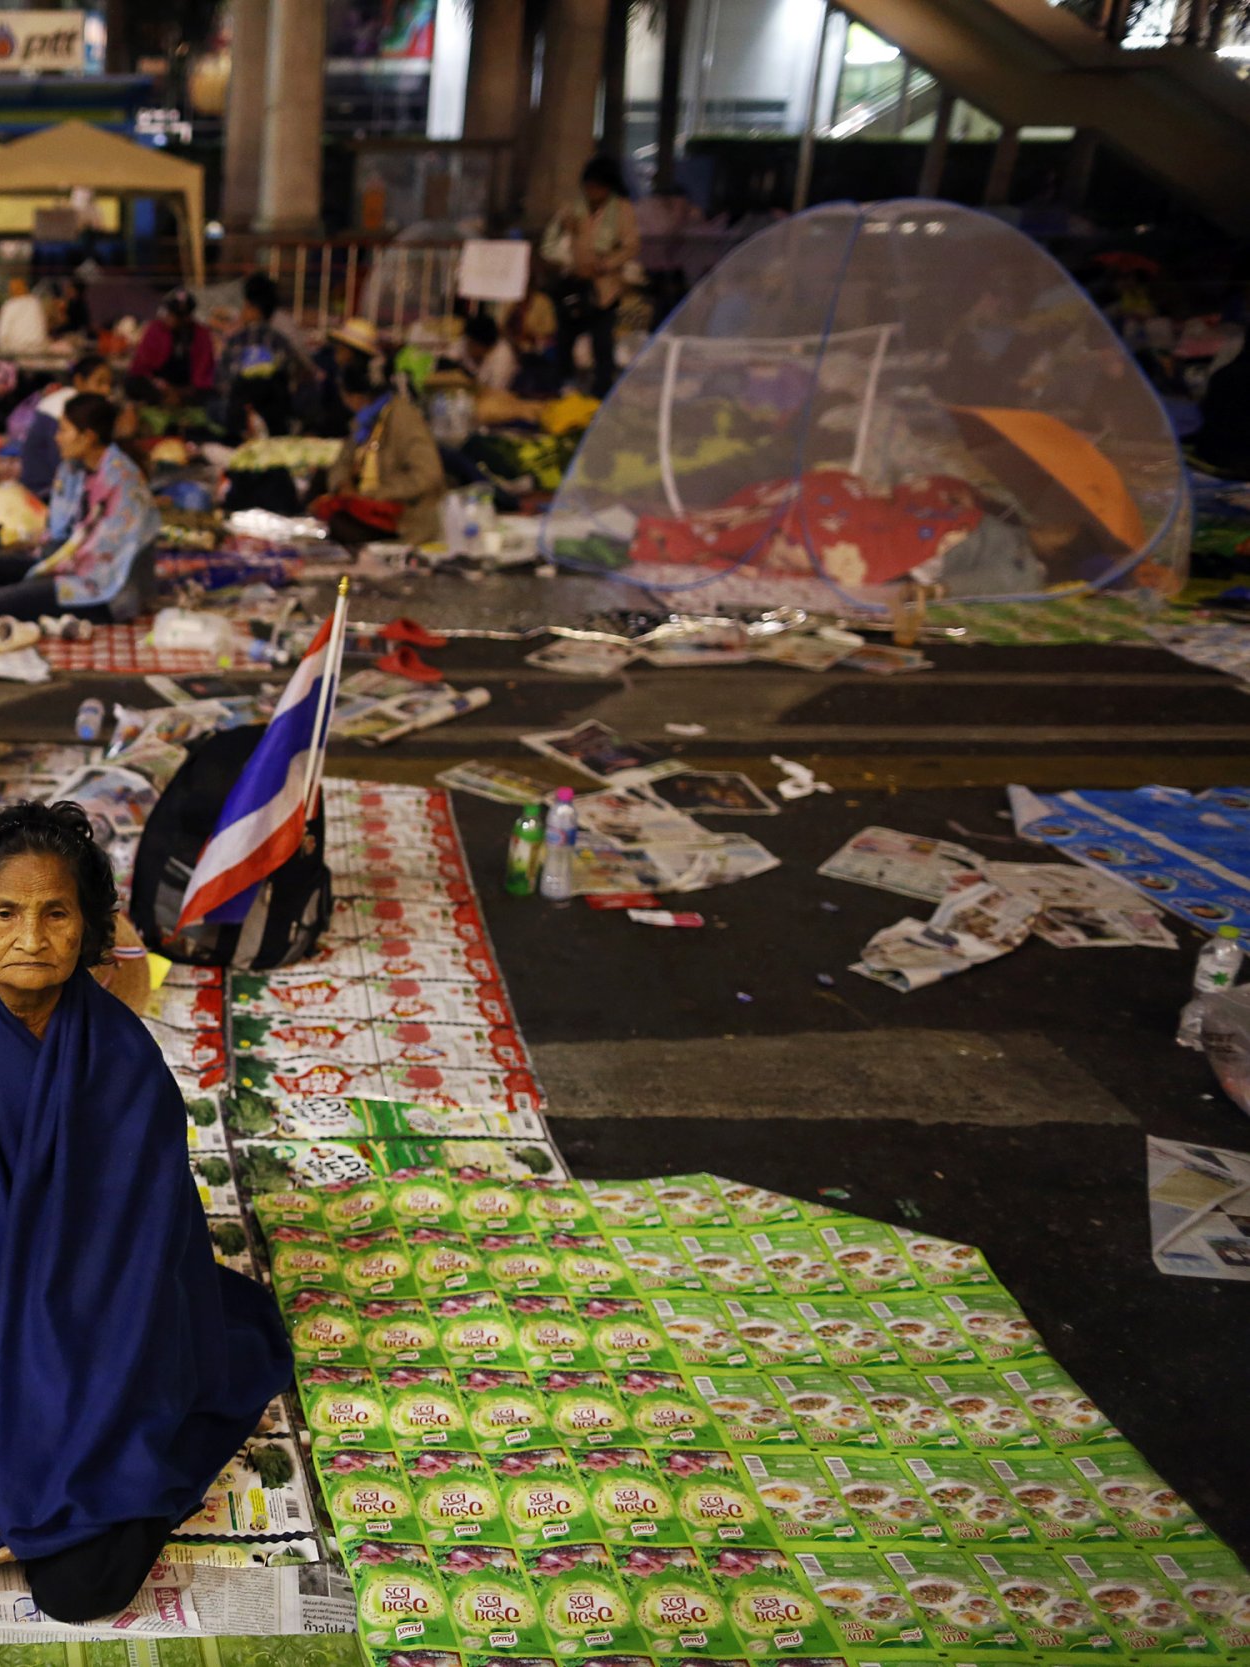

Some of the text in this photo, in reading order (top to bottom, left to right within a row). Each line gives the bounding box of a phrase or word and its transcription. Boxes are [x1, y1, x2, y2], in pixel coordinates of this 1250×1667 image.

[356, 1491, 379, 1504] ชัวร์
[442, 1492, 466, 1506] ชัวร์
[529, 1492, 553, 1506] ชัวร์
[615, 1490, 639, 1504] ชัวร์
[700, 1496, 724, 1508] ชัวร์
[353, 1499, 397, 1516] อร่อย
[440, 1501, 485, 1519] อร่อย
[527, 1500, 572, 1518] อร่อย
[614, 1498, 659, 1515] อร่อย
[700, 1503, 744, 1520] อร่อย
[385, 1587, 410, 1601] ชัวร์
[477, 1595, 501, 1609] ชัวร์
[569, 1595, 594, 1609] ชัวร์
[382, 1598, 429, 1615] อร่อย
[661, 1596, 686, 1611] ชัวร์
[753, 1597, 780, 1612] ชัวร์
[475, 1606, 521, 1625] อร่อย
[567, 1606, 614, 1625] อร่อย
[660, 1606, 708, 1626] อร่อย
[754, 1604, 802, 1625] อร่อย
